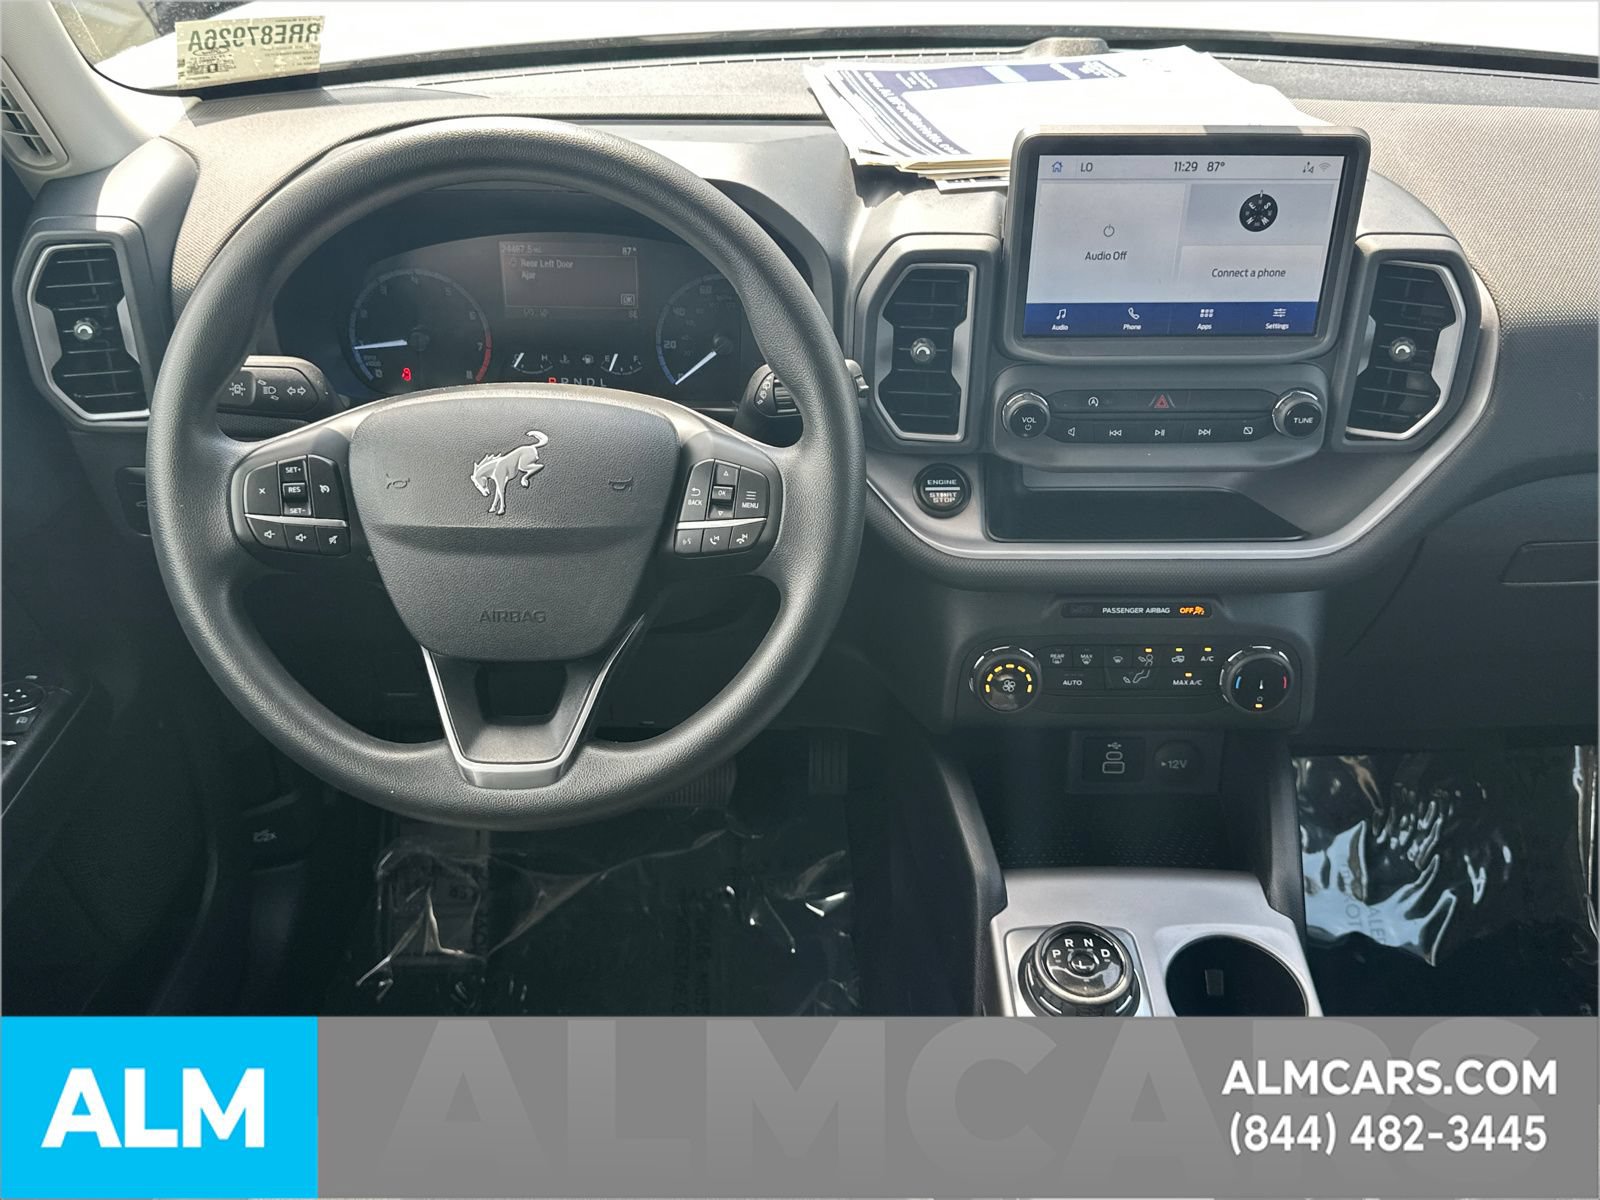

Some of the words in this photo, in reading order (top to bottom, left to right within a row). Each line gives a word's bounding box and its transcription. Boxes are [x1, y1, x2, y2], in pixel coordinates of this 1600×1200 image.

[1080, 162, 1093, 172] LO
[1173, 161, 1198, 172] 11:29
[1206, 161, 1226, 172] 87°
[1084, 251, 1112, 261] Audio
[1112, 250, 1127, 261] Off
[520, 260, 538, 268] Rear
[540, 260, 554, 268] Left
[556, 260, 573, 269] Door
[521, 271, 537, 280] Ajar
[1211, 268, 1248, 278] Connect
[1250, 270, 1256, 278] a
[1257, 268, 1286, 280] phone
[1123, 323, 1141, 331] Phone
[1197, 323, 1212, 331] Apps
[1265, 322, 1289, 331] Settings
[663, 340, 677, 349] 20
[586, 378, 595, 386] D
[479, 610, 546, 623] AIRBAG
[1167, 759, 1187, 769] 12V
[1052, 949, 1062, 958] P
[1064, 938, 1075, 948] R
[1083, 938, 1094, 948] N
[1100, 949, 1111, 958] D
